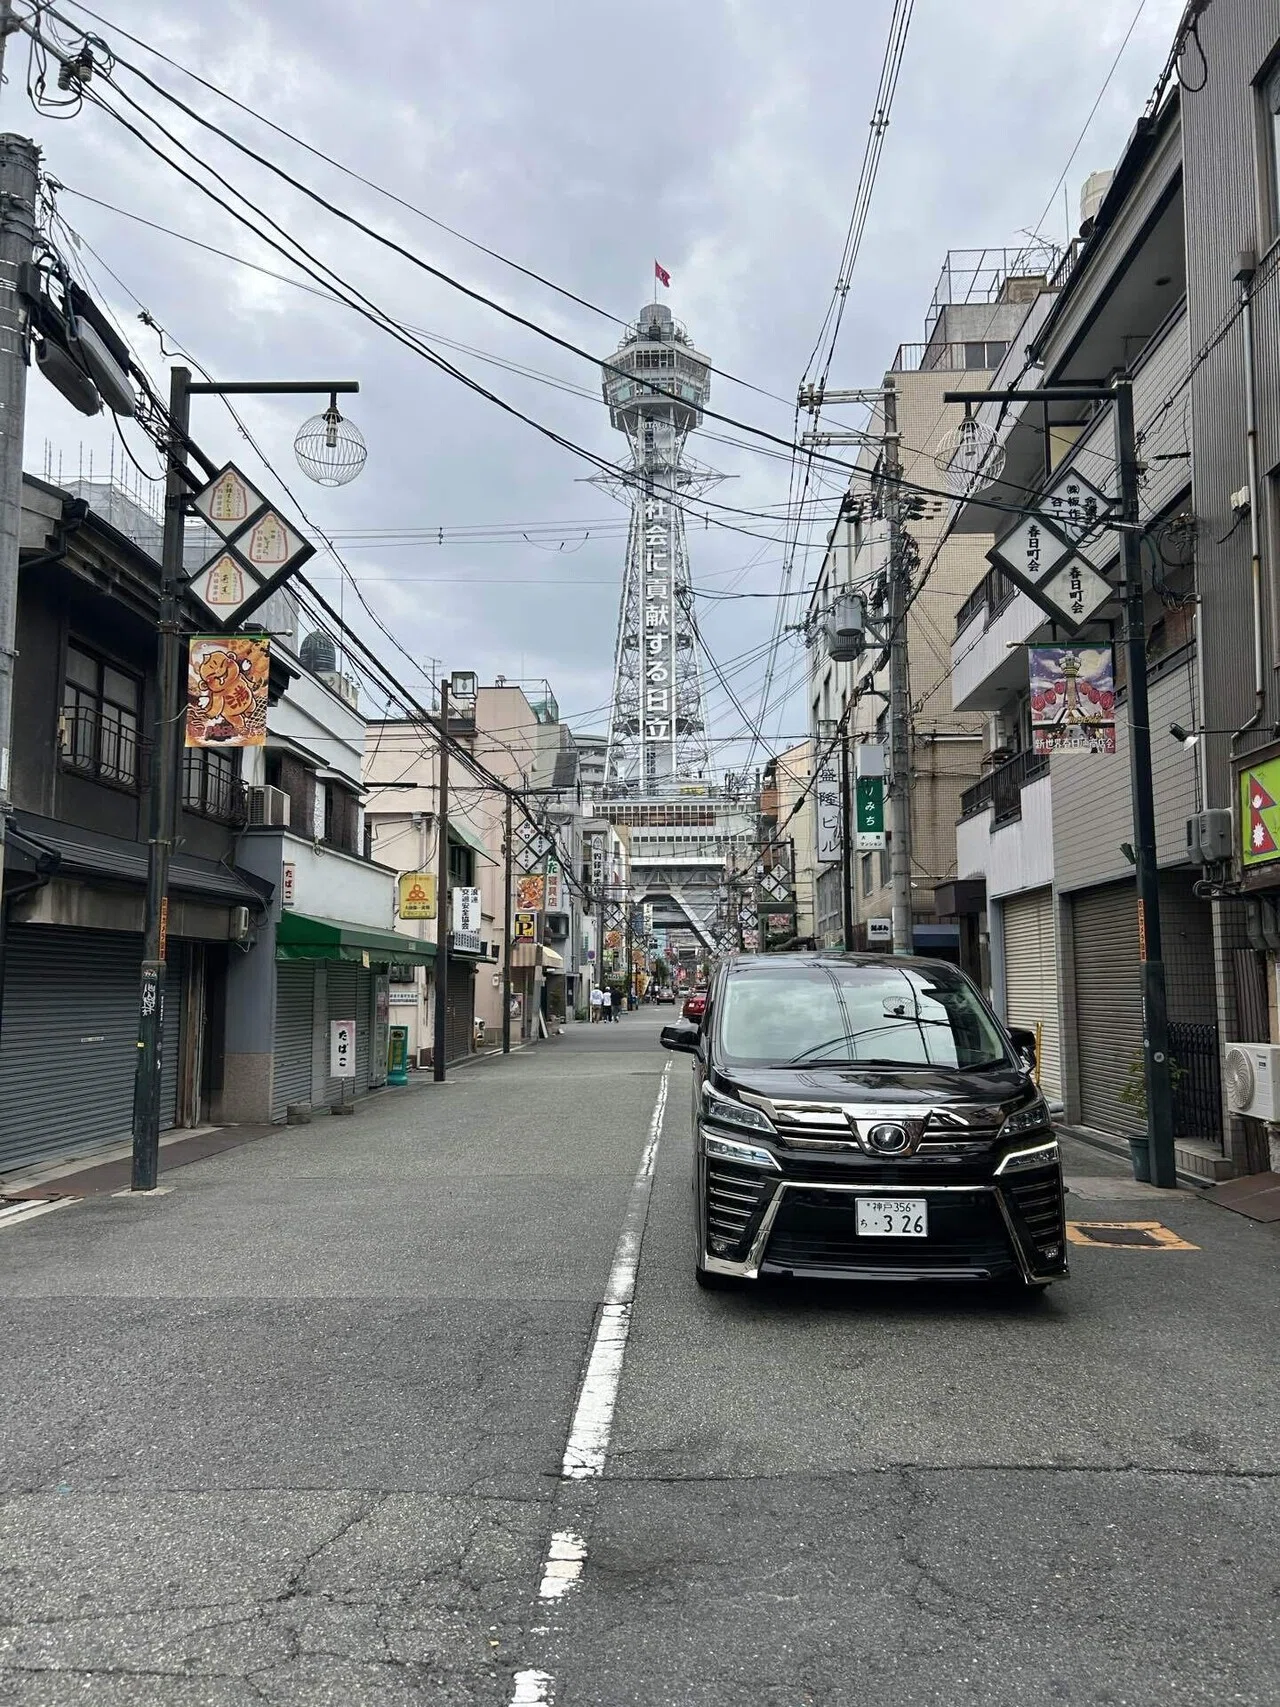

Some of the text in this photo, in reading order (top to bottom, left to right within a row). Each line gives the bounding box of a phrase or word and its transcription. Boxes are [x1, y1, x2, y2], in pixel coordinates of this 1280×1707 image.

[1027, 524, 1041, 572] 春日町会
[1069, 566, 1084, 614] 春日町会
[645, 498, 669, 741] 社会に貢献する日立
[818, 768, 841, 853] 盛隆ビル
[284, 869, 293, 899] たばこ
[462, 888, 470, 930] 交通安全協会
[518, 922, 532, 935] P
[338, 1030, 349, 1067] たばこ
